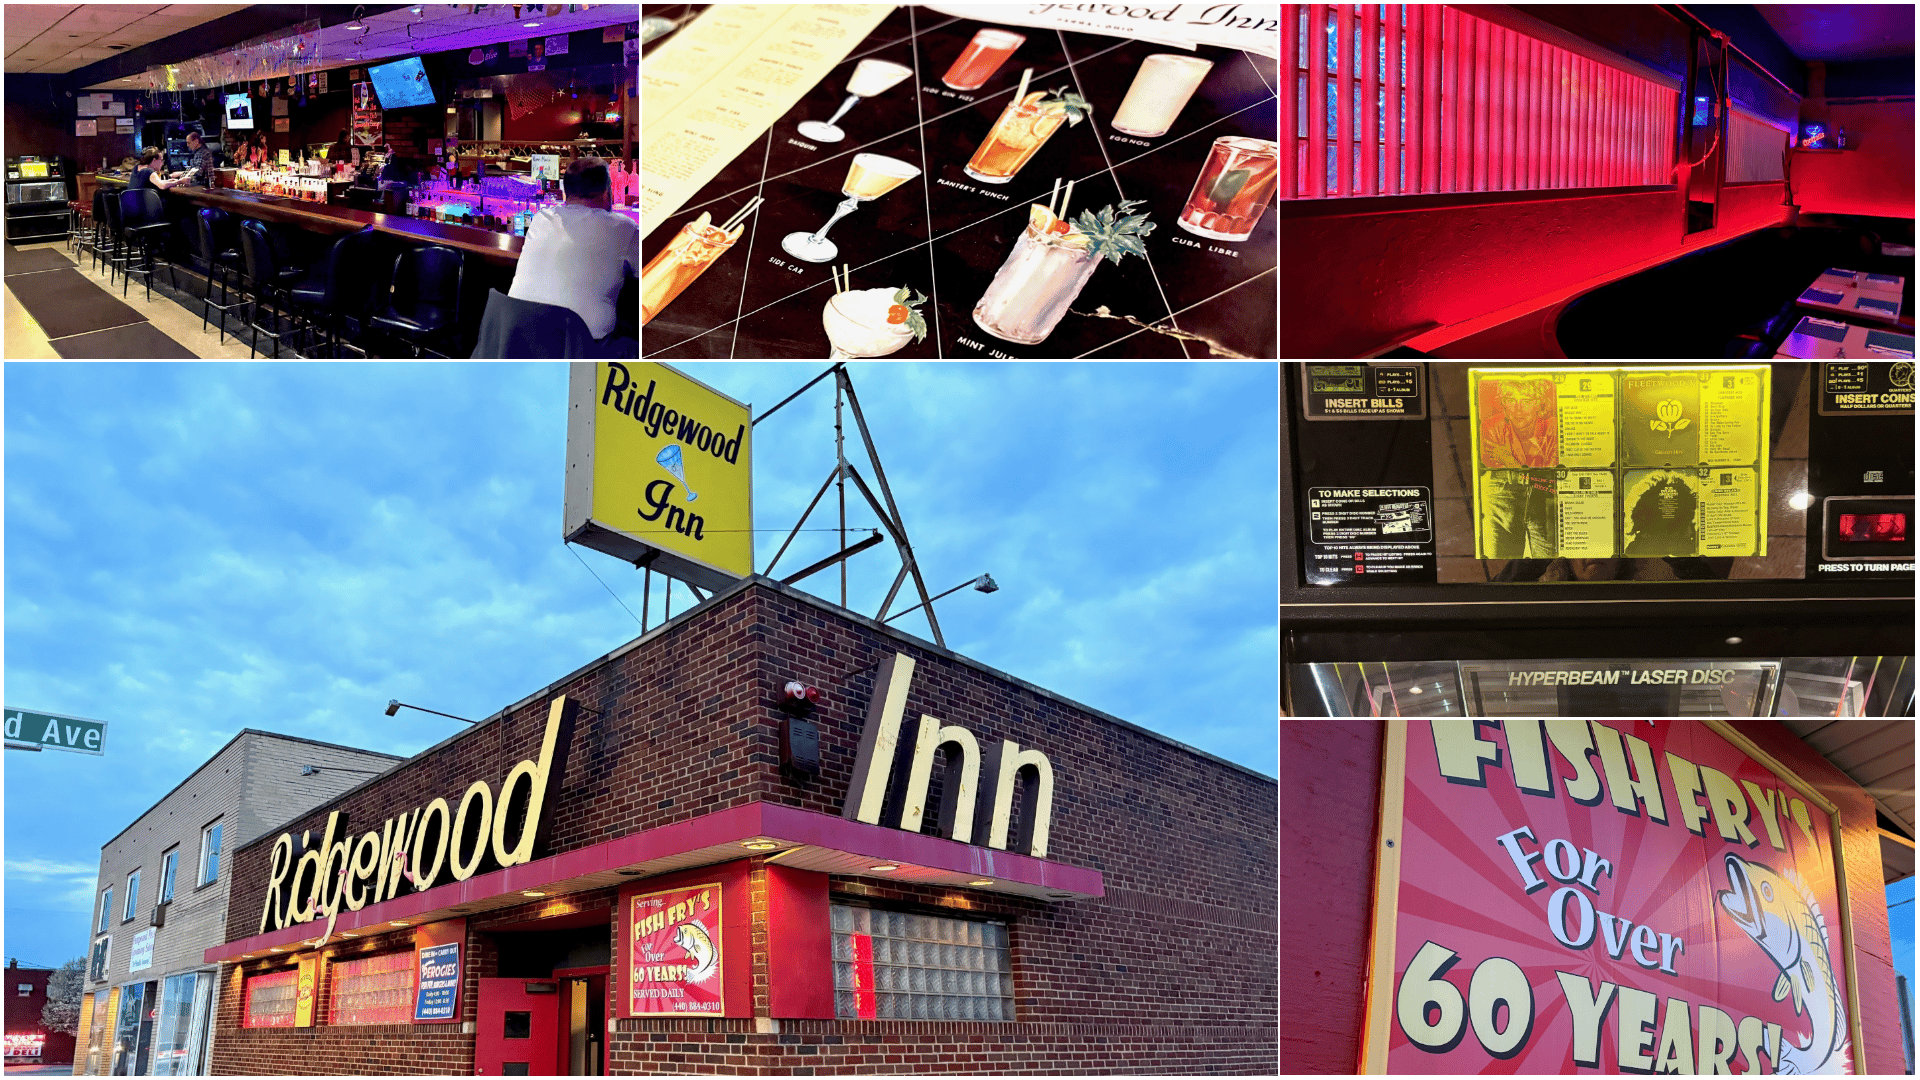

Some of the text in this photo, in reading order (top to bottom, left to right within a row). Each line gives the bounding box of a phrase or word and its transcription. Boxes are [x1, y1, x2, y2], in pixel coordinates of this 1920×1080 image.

[937, 178, 1009, 201] PLANTER'S PUNCH
[1172, 237, 1238, 257] CUBA LIBRE
[769, 257, 804, 274] SIDE CAR
[957, 336, 985, 351] MINT
[1325, 399, 1403, 408] INSERT BILLS
[1836, 394, 1915, 403] INSERT COINS
[602, 362, 745, 465] Ridgewood
[638, 480, 704, 541] Inn
[1630, 669, 1688, 685] LASER
[1691, 669, 1736, 684] DISC
[41, 719, 100, 748] Ave
[857, 652, 1054, 859] Inn
[1430, 720, 1817, 853] FISH FRY'S
[259, 694, 566, 949] Ridgewood
[1496, 825, 1612, 895] For
[635, 890, 711, 941] FISH FRY'S
[1546, 886, 1684, 974] Over
[645, 952, 665, 963] Over
[634, 964, 688, 983] 60 YEARS!
[633, 988, 684, 998] SERVED DAILY
[1396, 940, 1782, 1076] 60 YEARS!
